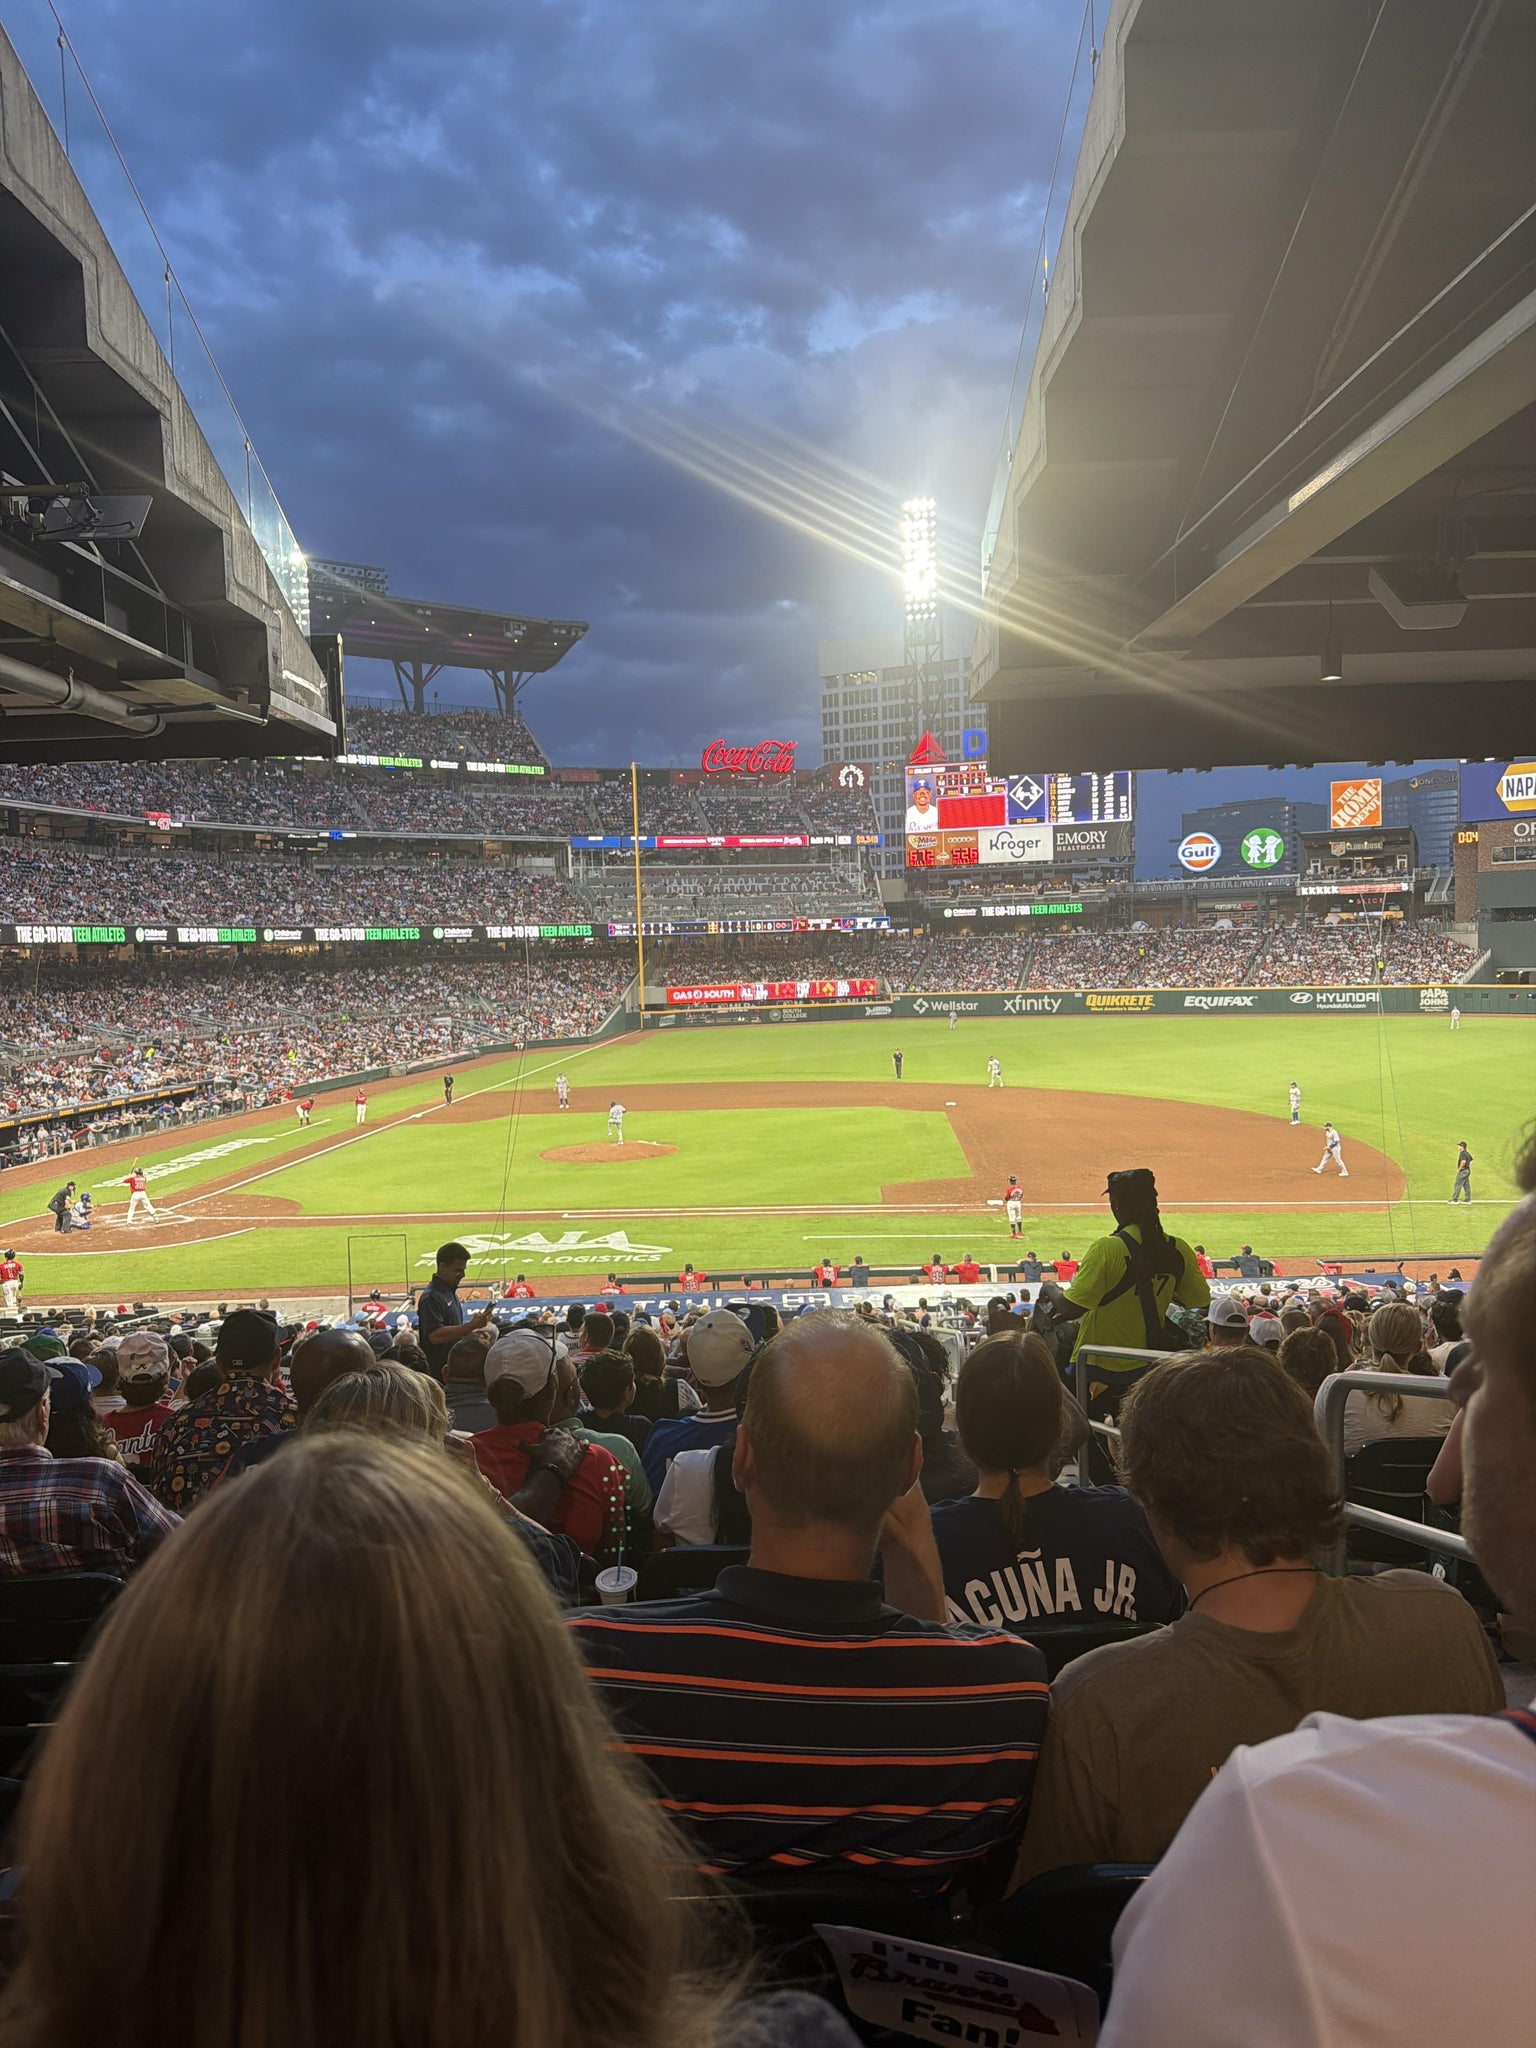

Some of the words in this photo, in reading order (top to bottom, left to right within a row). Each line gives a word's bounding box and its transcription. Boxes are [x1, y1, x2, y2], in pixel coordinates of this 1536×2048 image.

[394, 757, 423, 768] ATHLETES
[1336, 785, 1357, 806] THE
[1332, 780, 1380, 827] HOME
[1351, 796, 1380, 826] DEPOT
[1056, 831, 1108, 845] EMORY
[1458, 831, 1478, 844] 0:04
[989, 831, 1041, 859] Kroger
[1056, 843, 1106, 852] HEALTHCARE
[1181, 845, 1217, 858] Gulf
[909, 850, 934, 861] 672
[952, 848, 978, 860] 526
[981, 906, 995, 917] THE
[995, 905, 1016, 917] GO-TO
[1016, 905, 1031, 916] FOR
[1031, 904, 1048, 915] TEEN
[1048, 903, 1082, 914] ATHLETES
[16, 926, 33, 943] THE
[32, 926, 57, 943] GO-TO
[57, 927, 73, 943] FOR
[72, 927, 91, 943] TEEN
[91, 926, 125, 943] ATHLETES
[177, 927, 189, 942] THE
[188, 927, 207, 943] GO-TO
[207, 927, 219, 943] FOR
[218, 928, 232, 943] TEEN
[231, 928, 256, 943] ATHLETES
[314, 928, 330, 941] THE
[330, 928, 351, 942] GO-TO
[351, 928, 365, 941] FOR
[365, 928, 383, 941] TEEN
[382, 927, 420, 941] ATHLETES
[486, 926, 501, 939] THE
[501, 926, 524, 939] GO-TO
[524, 926, 540, 938] FOR
[540, 926, 557, 938] TEEN
[557, 925, 592, 938] ATHLETES
[673, 991, 693, 1000] GAS
[704, 989, 734, 998] SOUTH
[1085, 994, 1154, 1006] QUIKRETE
[1316, 991, 1380, 1003] HYUNDAI
[1420, 988, 1449, 998] PAPA
[930, 1000, 979, 1011] Wellstar
[1003, 994, 1062, 1013] xfinity
[1183, 995, 1254, 1009] EQUIFAX
[1419, 997, 1449, 1006] JOHNS
[421, 1231, 673, 1260] SAIA
[542, 1254, 662, 1264] LOGISTICS
[945, 1547, 1083, 1628] ACUÑA
[872, 1940, 959, 1975] I'm
[973, 1969, 1009, 1988] a
[850, 1952, 1017, 2008] Braves
[902, 1998, 1022, 2048] Fan!
